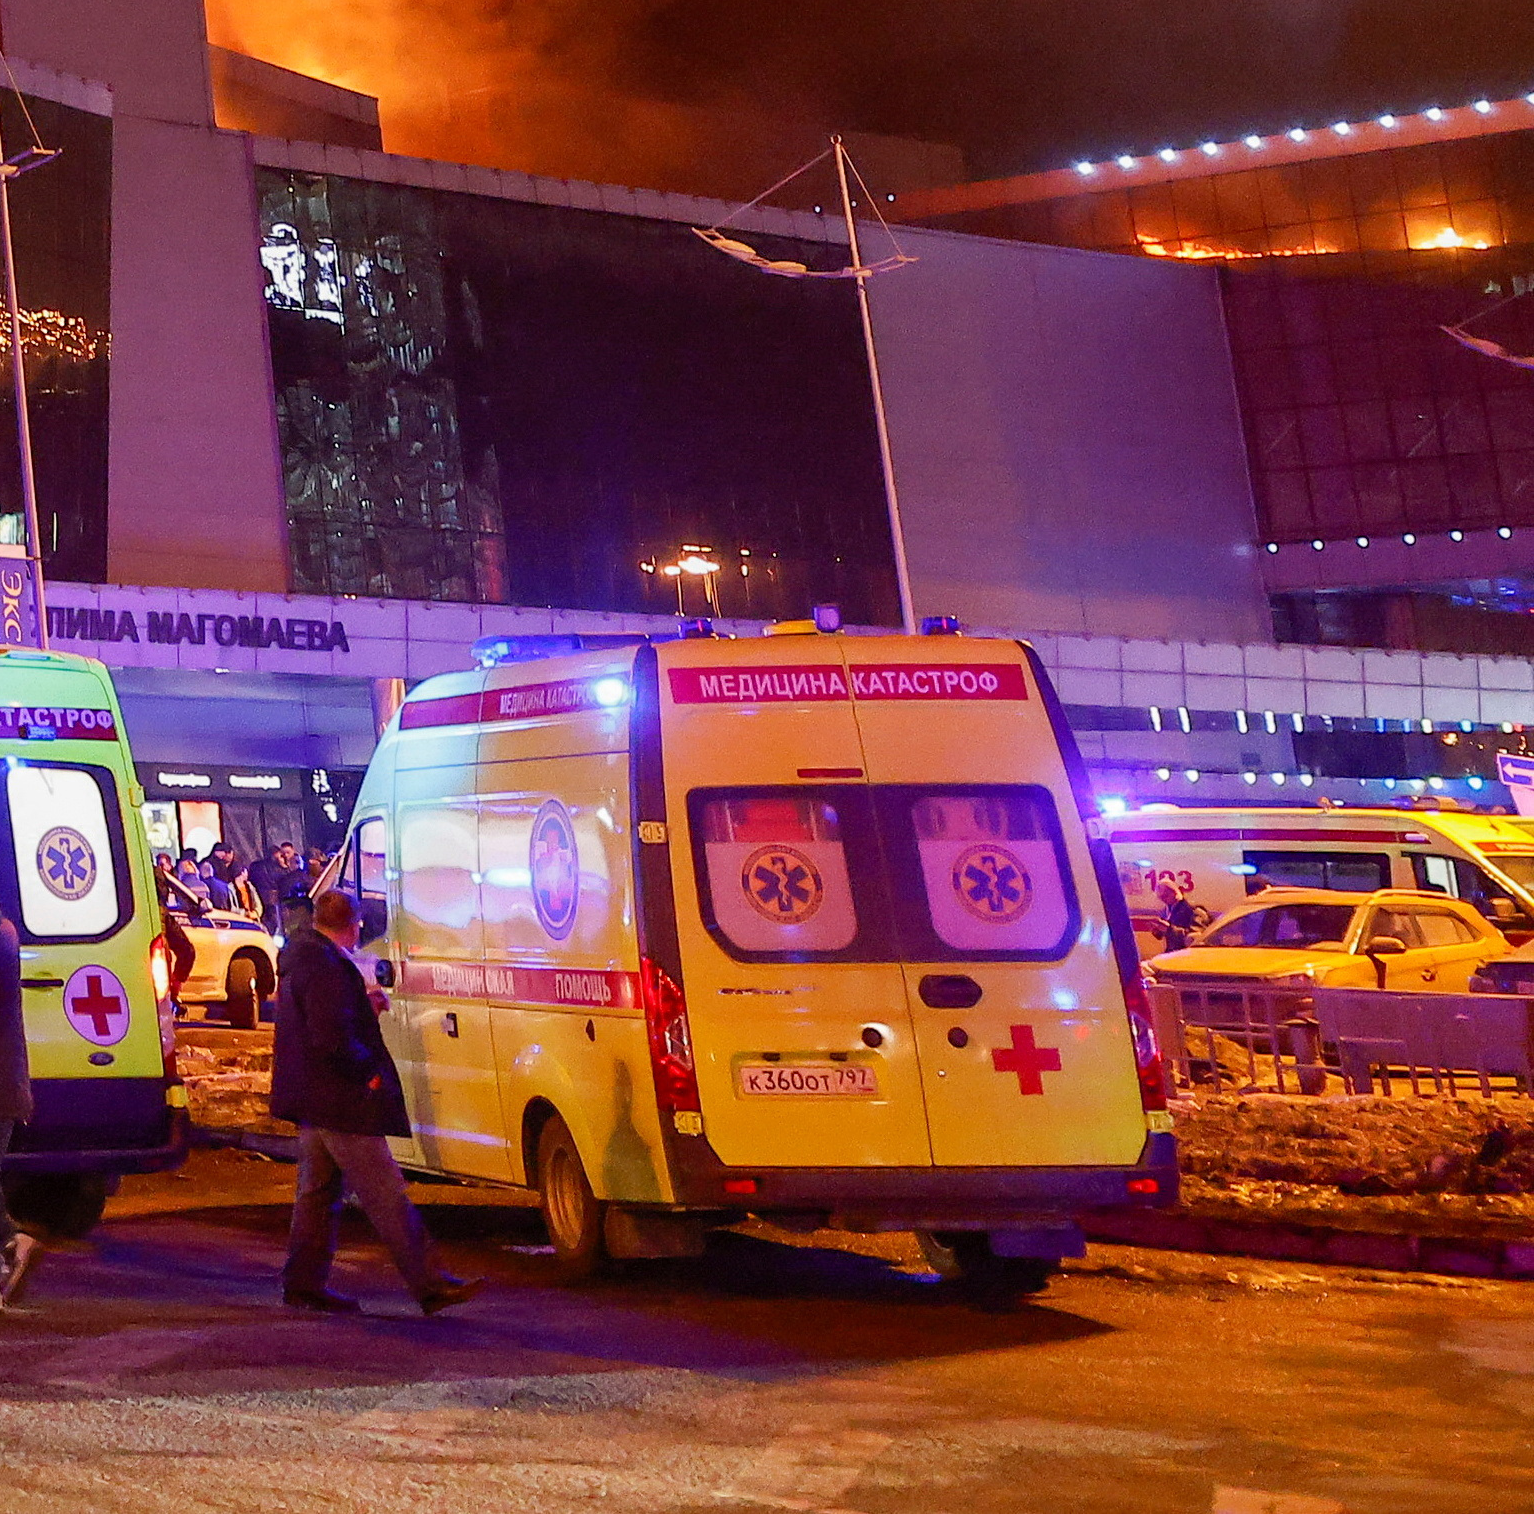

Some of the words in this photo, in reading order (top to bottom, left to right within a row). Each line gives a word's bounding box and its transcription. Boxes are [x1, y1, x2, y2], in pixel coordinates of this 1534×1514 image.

[147, 610, 350, 653] МАГОМАЕВА
[699, 672, 847, 700] МЕДИЦИНА
[852, 670, 999, 694] КАТАСТРОФ
[555, 973, 612, 1005] ПОМОЩЬ
